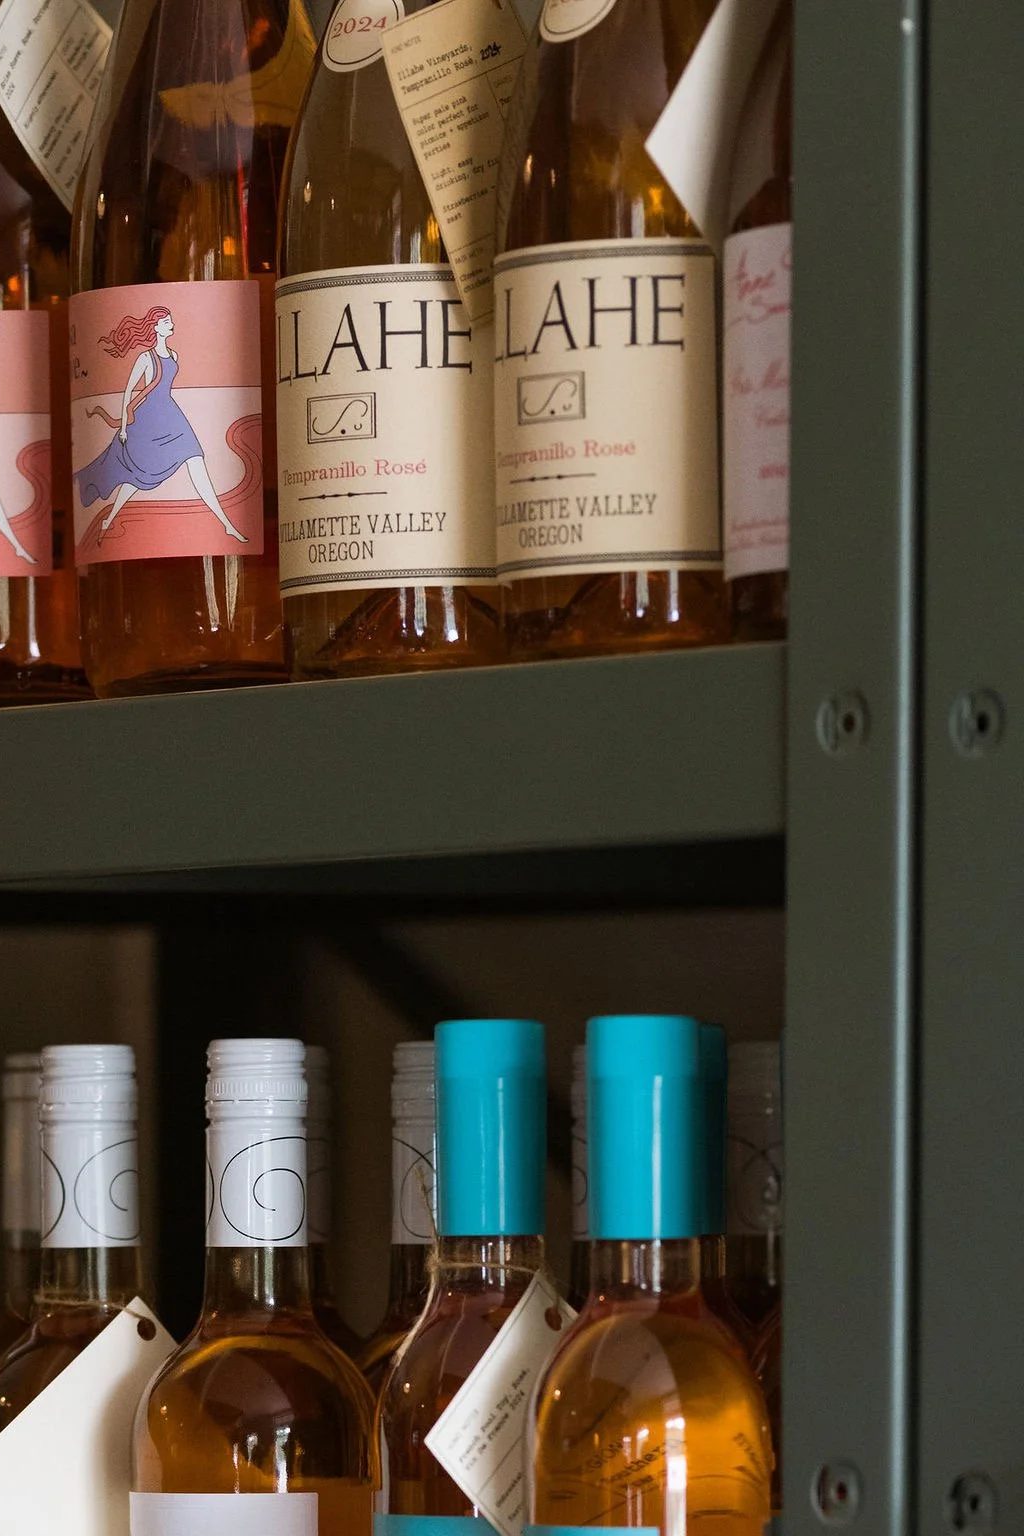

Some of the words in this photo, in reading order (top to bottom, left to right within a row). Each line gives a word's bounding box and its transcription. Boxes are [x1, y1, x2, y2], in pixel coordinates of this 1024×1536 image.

[331, 15, 389, 40] 2024
[397, 63, 425, 81] Illahe
[401, 68, 452, 95] Tempranillo
[583, 439, 636, 458] Rosé
[283, 461, 367, 487] Tempranillo
[374, 457, 427, 476] Rosé
[575, 493, 657, 518] VALLEY
[367, 511, 447, 535] VALLEY
[518, 523, 583, 549] OREGON
[308, 540, 375, 563] OREGON
